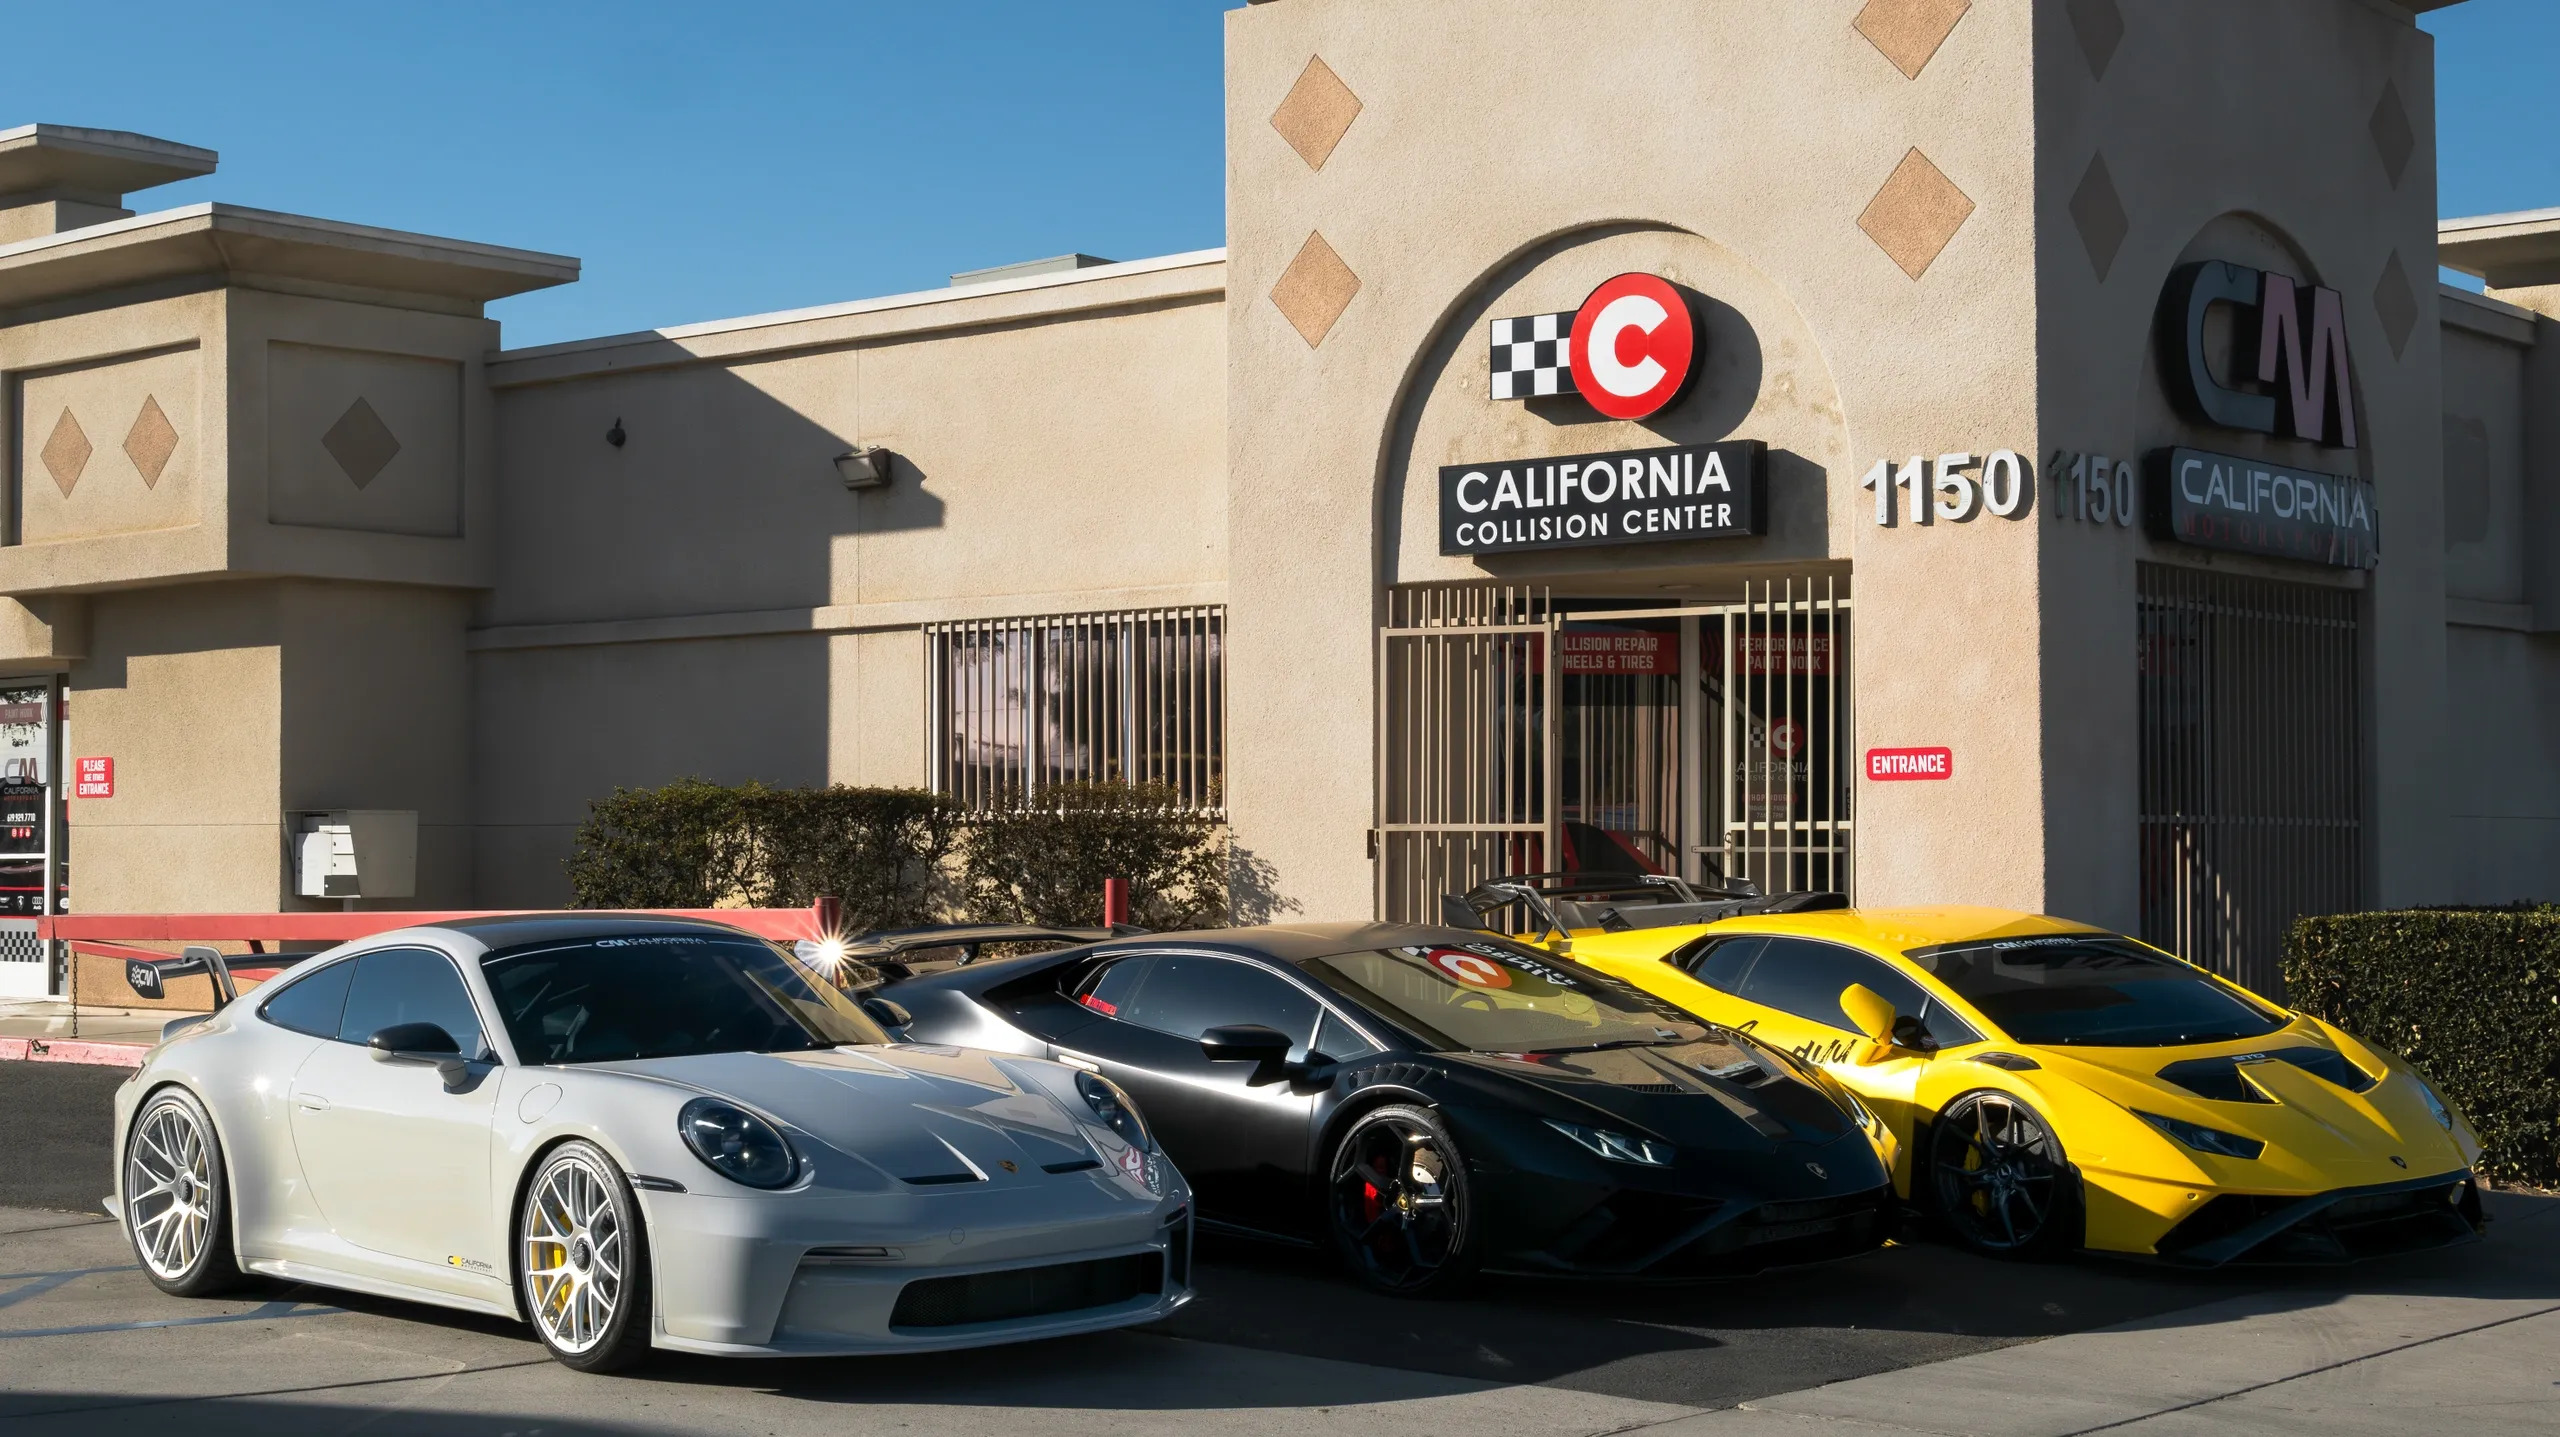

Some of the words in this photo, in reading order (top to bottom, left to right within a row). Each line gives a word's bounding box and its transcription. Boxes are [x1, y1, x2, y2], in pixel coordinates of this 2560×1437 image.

[1587, 294, 1669, 398] C
[2187, 259, 2358, 448] CM
[1456, 451, 1731, 514] CALIFORNIA
[1860, 448, 2022, 525] 1150
[2047, 451, 2134, 528] 1150
[2180, 458, 2370, 532] CALIFORNIA
[1456, 513, 1608, 546] COLLISION
[1622, 503, 1732, 535] CENTER
[1563, 637, 1611, 651] LLISION
[1614, 637, 1658, 651] REPAIR
[1562, 655, 1603, 669] HEELS
[1607, 655, 1616, 669] &
[1620, 655, 1654, 669] TIRES
[83, 759, 106, 772] PLEASE
[1872, 754, 1946, 774] ENTRANCE
[4, 787, 39, 795] CALIFORNIA
[79, 782, 110, 795] ENTRANCE
[461, 1257, 493, 1269] CALIFORNIA
